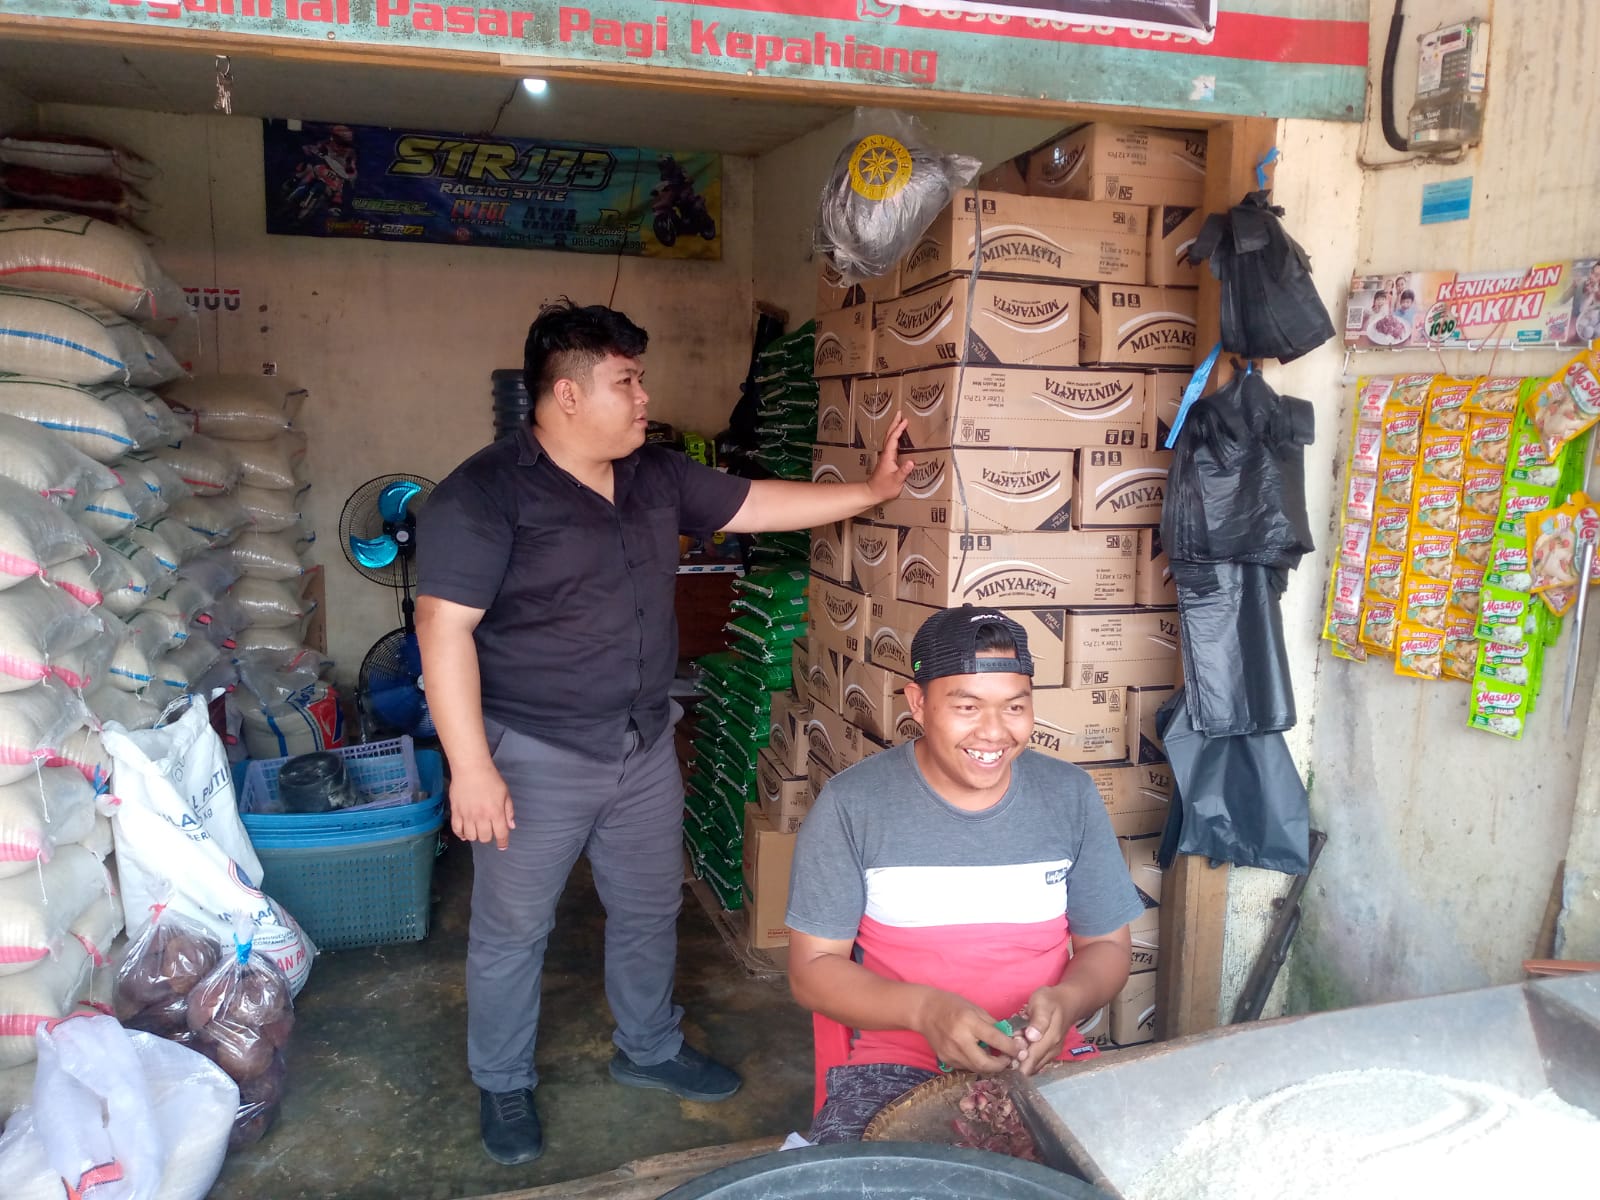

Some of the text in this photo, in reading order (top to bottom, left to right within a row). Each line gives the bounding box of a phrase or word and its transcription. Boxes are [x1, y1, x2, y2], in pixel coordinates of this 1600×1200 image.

[376, 0, 534, 38] Pasar
[559, 6, 668, 58] Pagi
[690, 19, 937, 83] Kepahiang
[440, 183, 570, 203] RACING STYLE
[1109, 486, 1164, 513] MINYA
[1506, 495, 1550, 509] Masako
[1482, 600, 1523, 613] Masako
[1476, 692, 1520, 706] Masako
